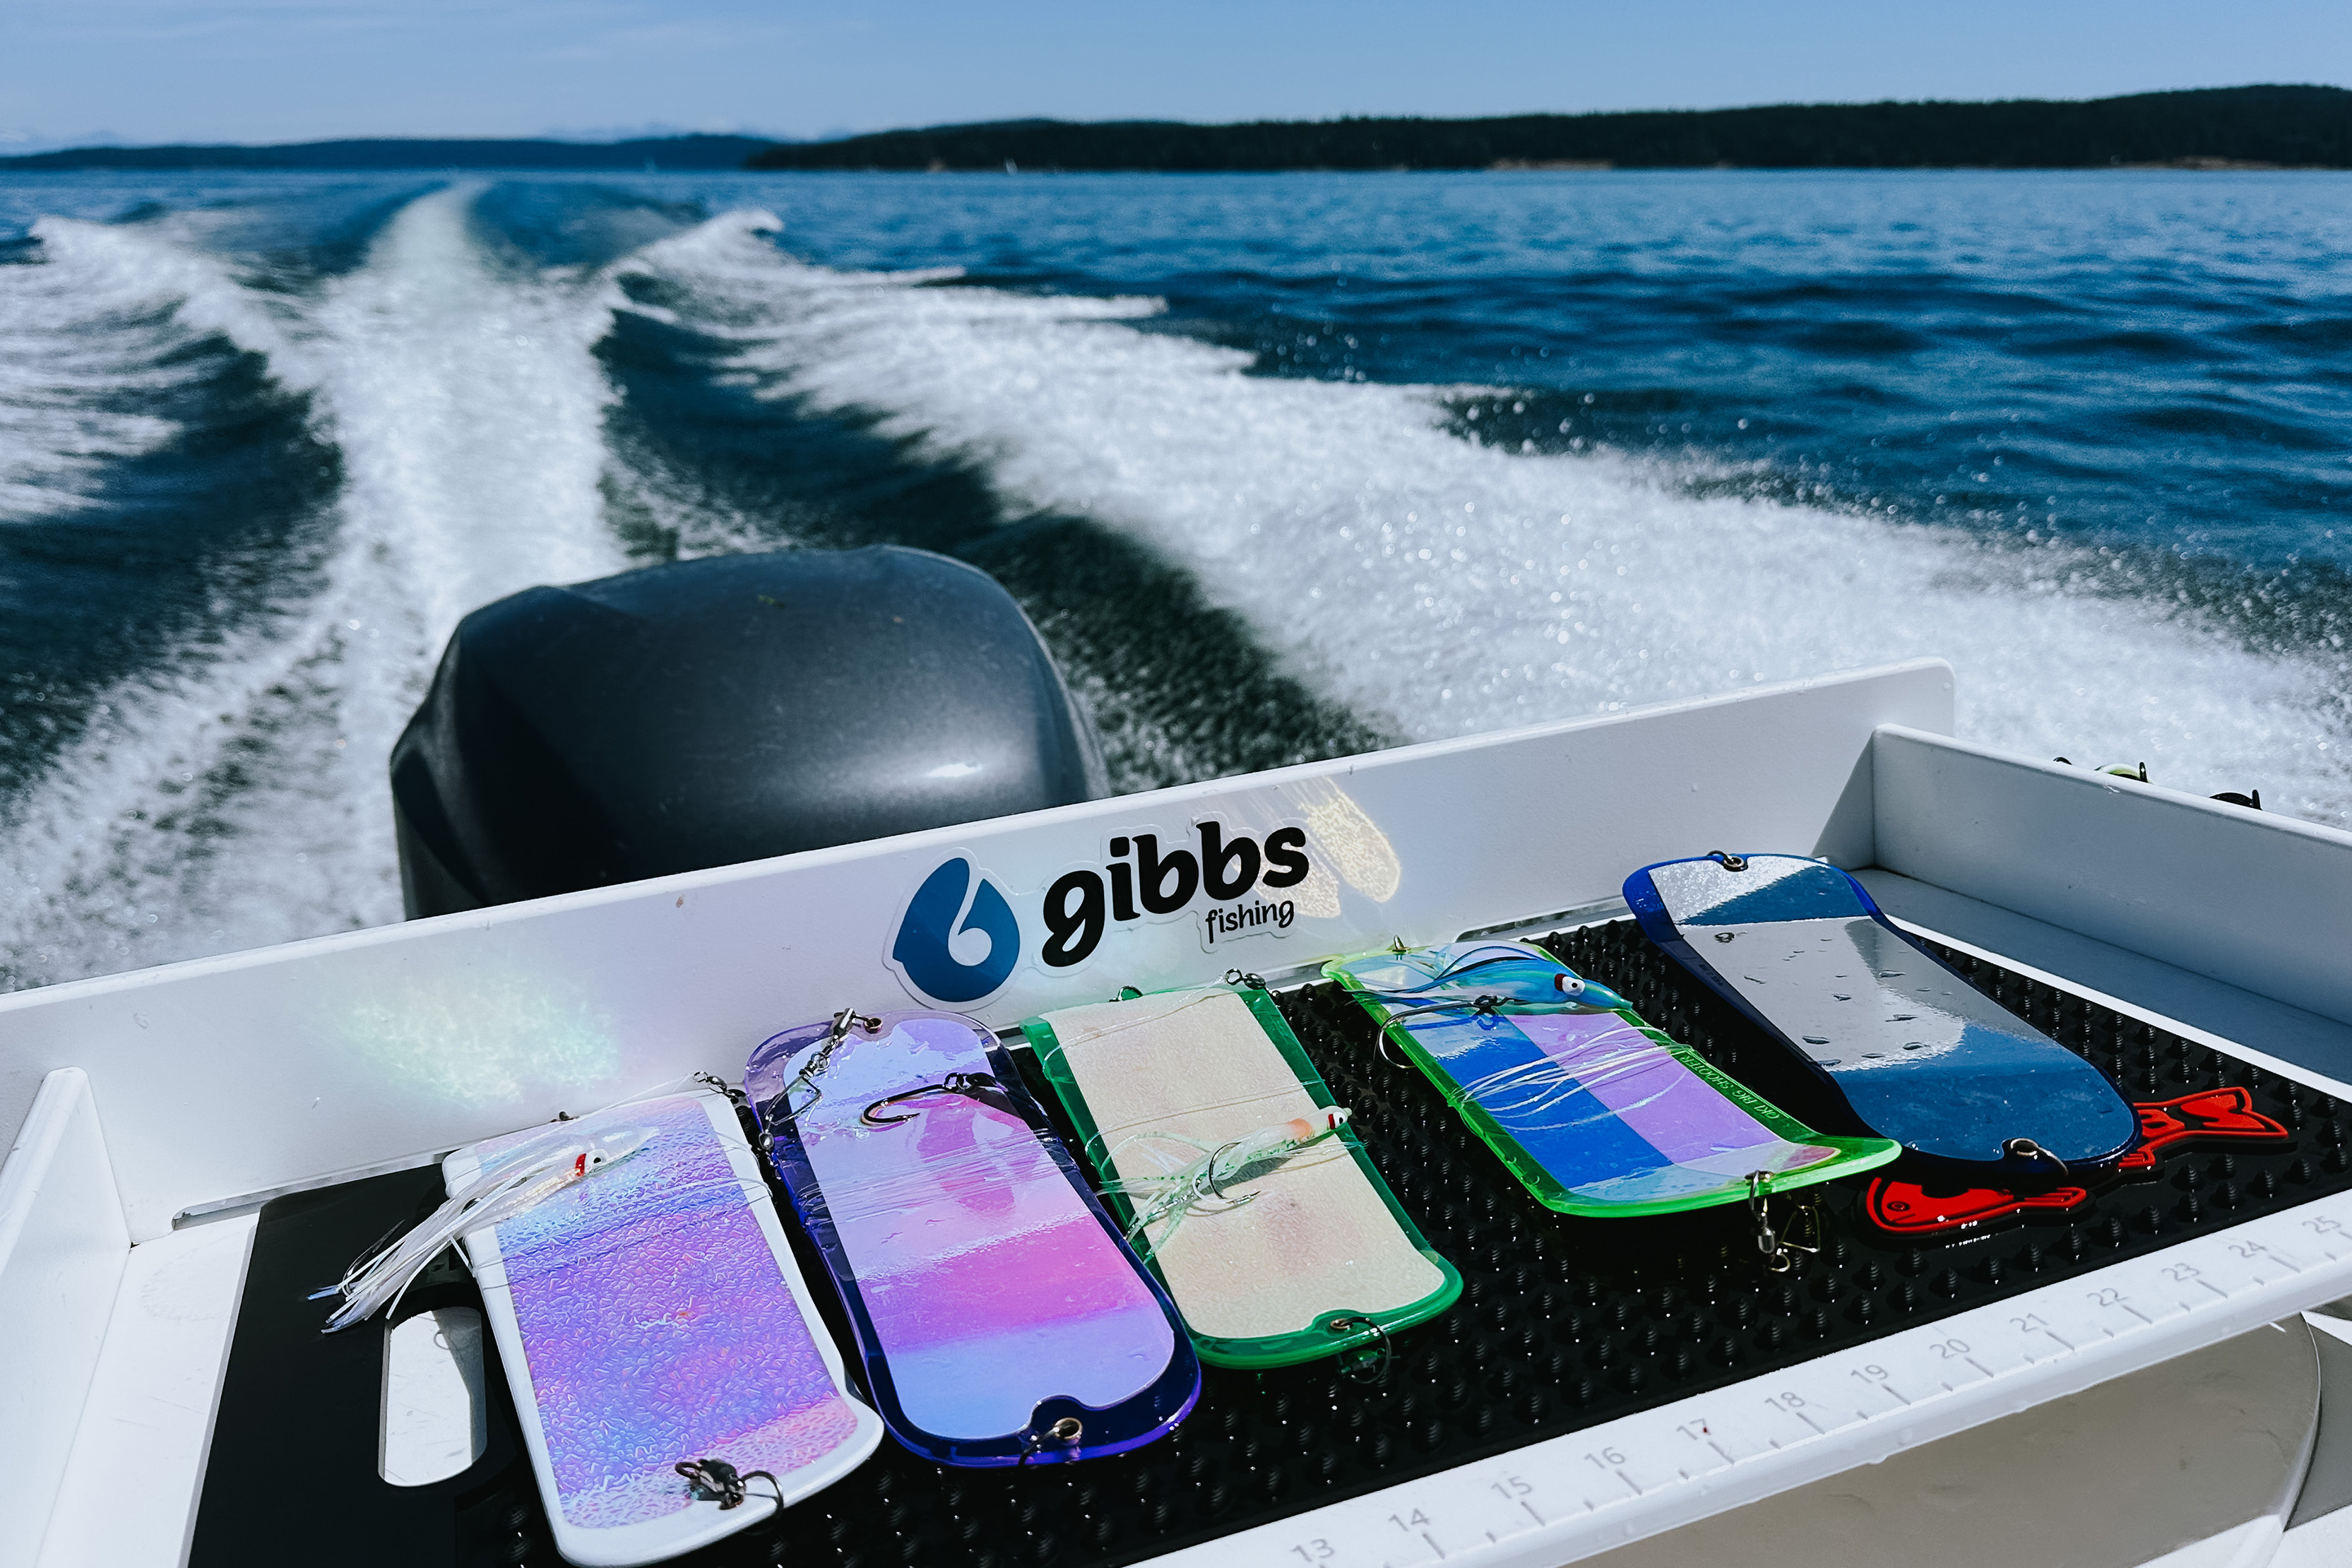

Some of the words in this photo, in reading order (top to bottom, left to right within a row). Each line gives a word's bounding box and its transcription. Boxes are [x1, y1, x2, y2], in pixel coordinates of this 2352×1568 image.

[1042, 820, 1310, 968] gibbs
[1205, 900, 1295, 944] fishing
[1680, 1055, 1734, 1090] SHOOTER
[1732, 1090, 1757, 1105] BIG
[1753, 1104, 1781, 1119] OKI
[1290, 1538, 1335, 1563] 13
[1387, 1507, 1430, 1532] 14
[1490, 1475, 1533, 1499] 15
[1583, 1446, 1626, 1470] 16
[1675, 1418, 1711, 1441] 17
[1764, 1391, 1805, 1413] 18
[1851, 1364, 1889, 1384] 19
[1930, 1338, 1971, 1360] 20
[2009, 1312, 2049, 1333] 21
[2086, 1287, 2130, 1307] 22
[2161, 1262, 2201, 1282] 23
[2227, 1240, 2267, 1259] 24
[2301, 1215, 2342, 1235] 25
